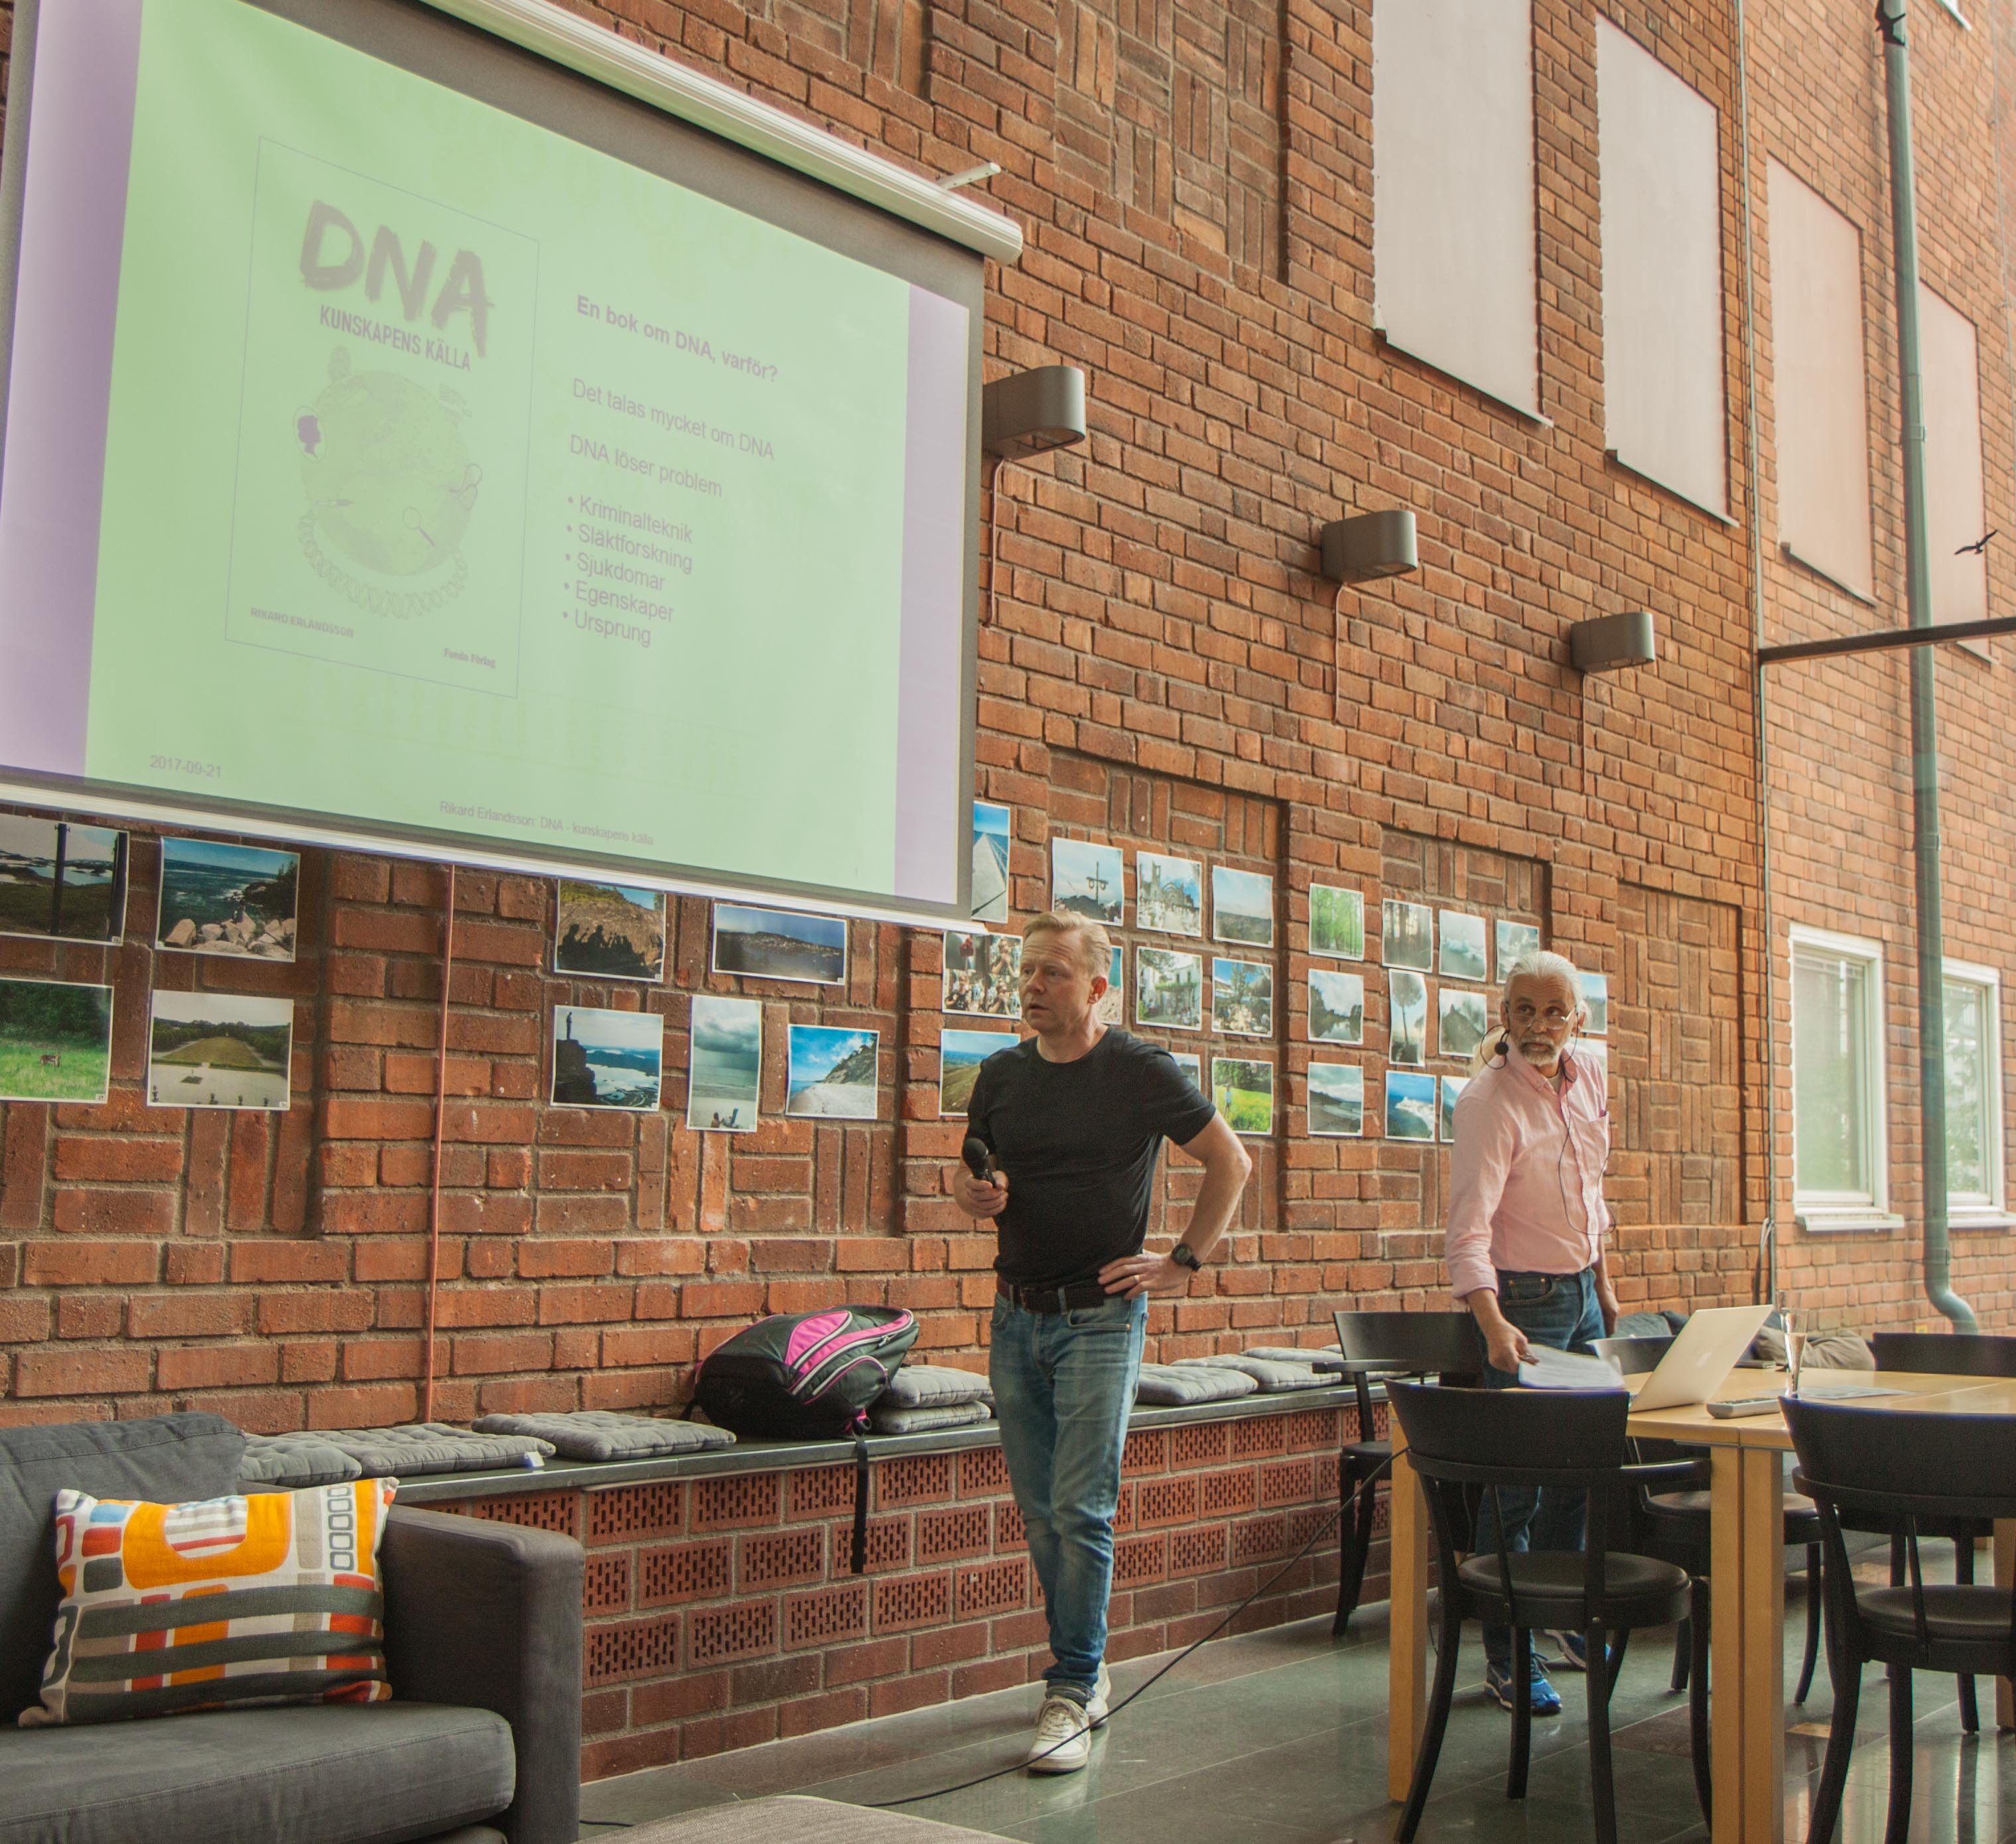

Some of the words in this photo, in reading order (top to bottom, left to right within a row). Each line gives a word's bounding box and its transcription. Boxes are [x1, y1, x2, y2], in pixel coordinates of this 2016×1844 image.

[299, 198, 495, 359] DNA
[320, 304, 421, 356] KUNSKAPENS
[425, 337, 471, 372] KÄLLA
[576, 295, 600, 320] En
[606, 305, 638, 334] bok
[643, 324, 669, 344] om
[675, 330, 716, 364] DNA,
[722, 351, 778, 383] varför?
[572, 378, 602, 405] Det
[607, 390, 645, 419] talas
[650, 407, 706, 439] mycket
[710, 428, 734, 448] om
[739, 432, 774, 460] DNA
[570, 434, 610, 464] DNA
[615, 448, 655, 476] löser
[659, 466, 722, 497] problem
[579, 495, 693, 543] Kriminalteknik
[577, 552, 666, 592] Sjukdomar
[578, 523, 693, 575] Släktforskning
[250, 607, 288, 624] RIKARD
[290, 615, 354, 638] ERLANDSSON
[575, 580, 674, 622] Egenskaper
[574, 608, 651, 648] Ursprung
[150, 754, 222, 778] 2017-09-21
[440, 801, 474, 818] Rikard
[540, 816, 563, 830] DNA
[572, 823, 630, 842] kunskapens
[632, 831, 653, 846] källa
